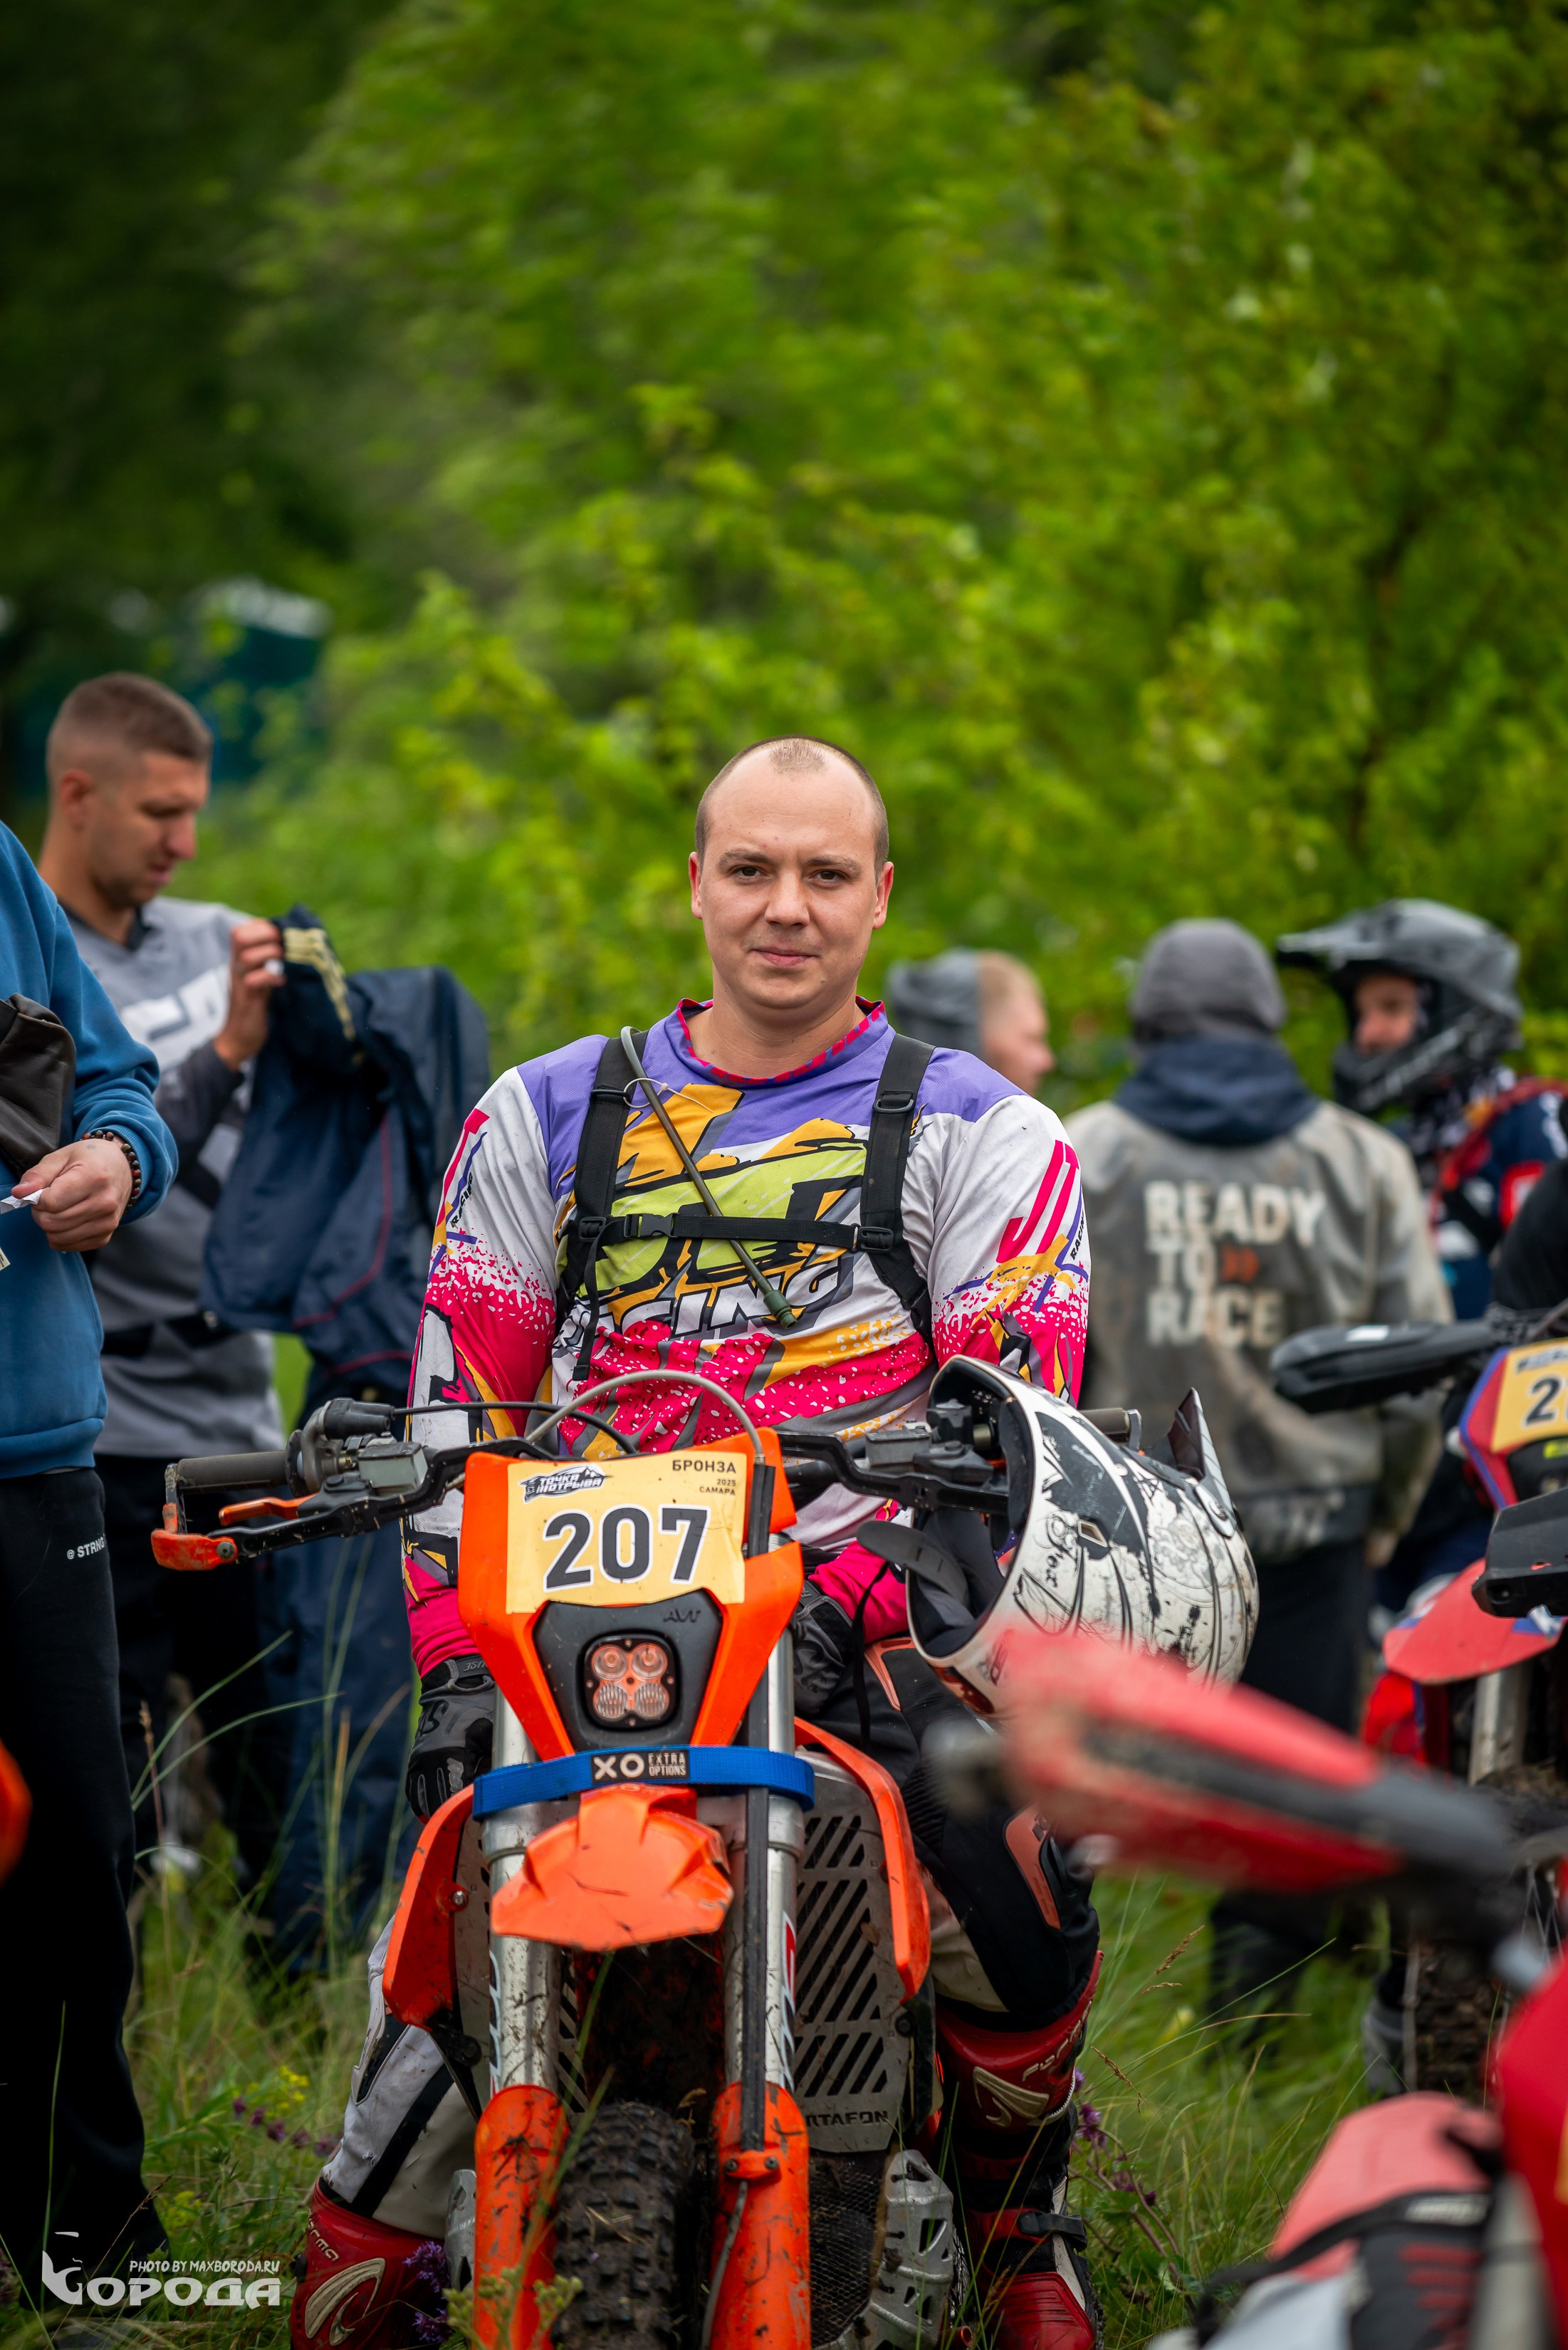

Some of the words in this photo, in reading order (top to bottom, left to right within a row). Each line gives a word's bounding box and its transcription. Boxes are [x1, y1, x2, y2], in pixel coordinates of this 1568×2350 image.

[1145, 1181, 1326, 1246] READY
[1146, 1241, 1216, 1288] TO
[1148, 1288, 1284, 1348] RACE
[1525, 1377, 1564, 1426] 2
[672, 1460, 736, 1474] БРОНЗА
[540, 1473, 580, 1486] ТОЧКА
[549, 1478, 602, 1493] ОТРЫВА
[699, 1486, 736, 1495] САМАРА
[77, 1534, 105, 1557] STRNG
[544, 1505, 709, 1590] 207
[593, 1753, 645, 1780] XO
[648, 1753, 686, 1766] EXTRA
[649, 1765, 686, 1777] OPTIONS
[805, 2110, 889, 2128] RTAFON
